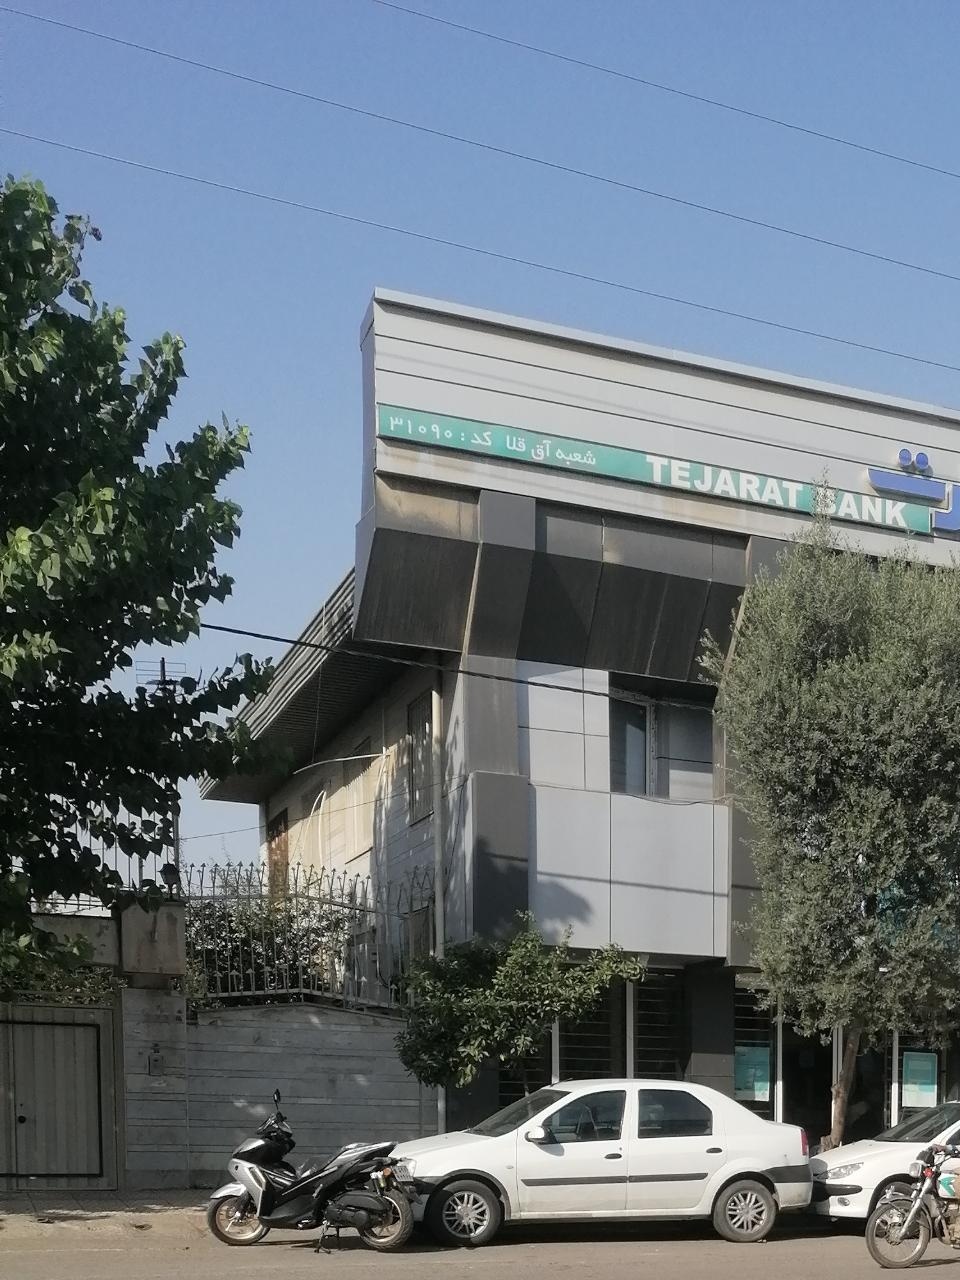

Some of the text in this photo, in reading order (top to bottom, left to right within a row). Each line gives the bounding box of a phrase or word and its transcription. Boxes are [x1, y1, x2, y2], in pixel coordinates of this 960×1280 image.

[506, 434, 527, 452] قلا
[531, 440, 552, 461] آق
[555, 449, 596, 465] شعبه
[645, 455, 804, 508] TEJARAT
